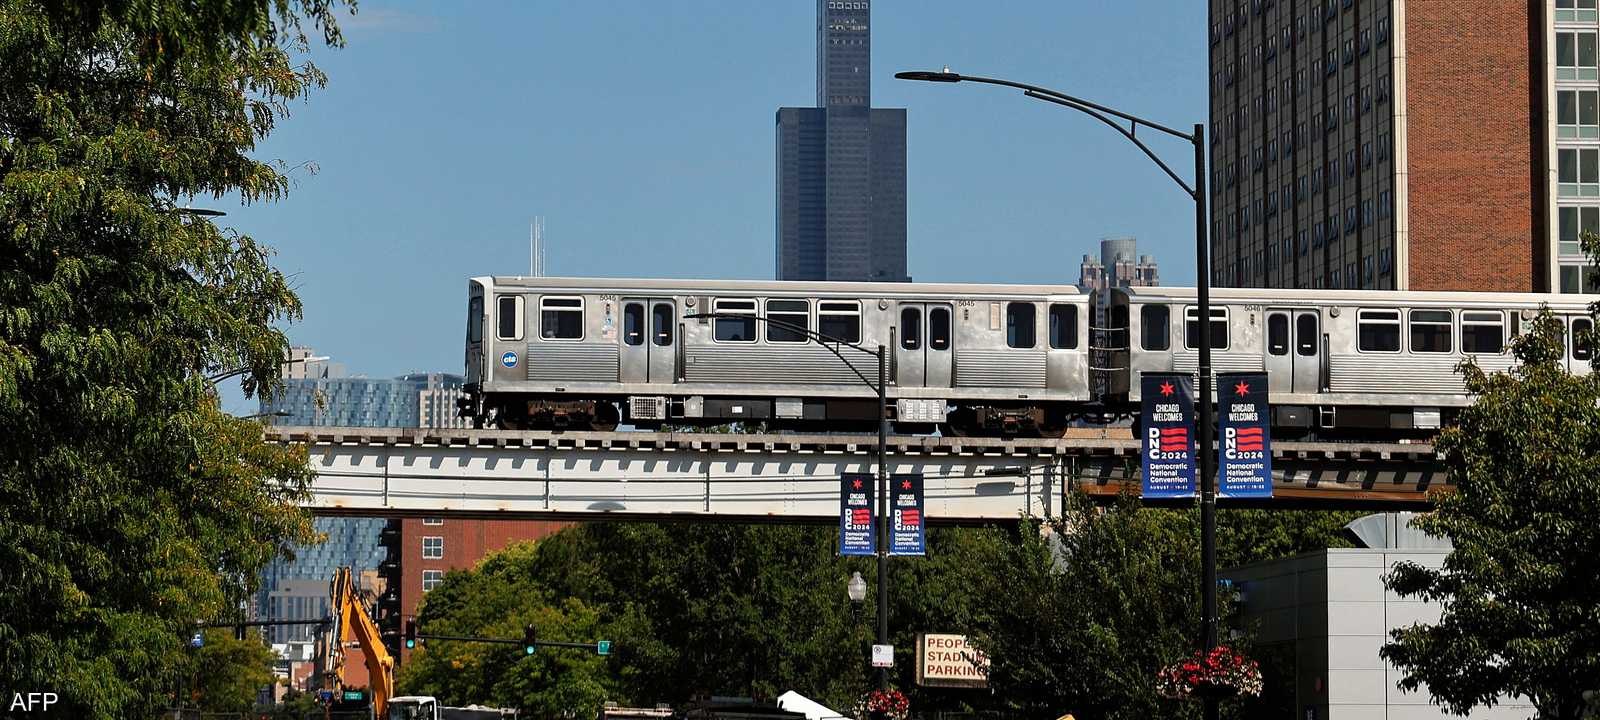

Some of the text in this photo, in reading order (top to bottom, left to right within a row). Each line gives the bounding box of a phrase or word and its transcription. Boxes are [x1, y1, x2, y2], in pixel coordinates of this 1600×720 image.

[1155, 403, 1180, 412] CHICAGO
[1231, 403, 1255, 412] CHICAGO
[1153, 412, 1183, 422] WELCOMES
[1229, 412, 1259, 422] WELCOMES
